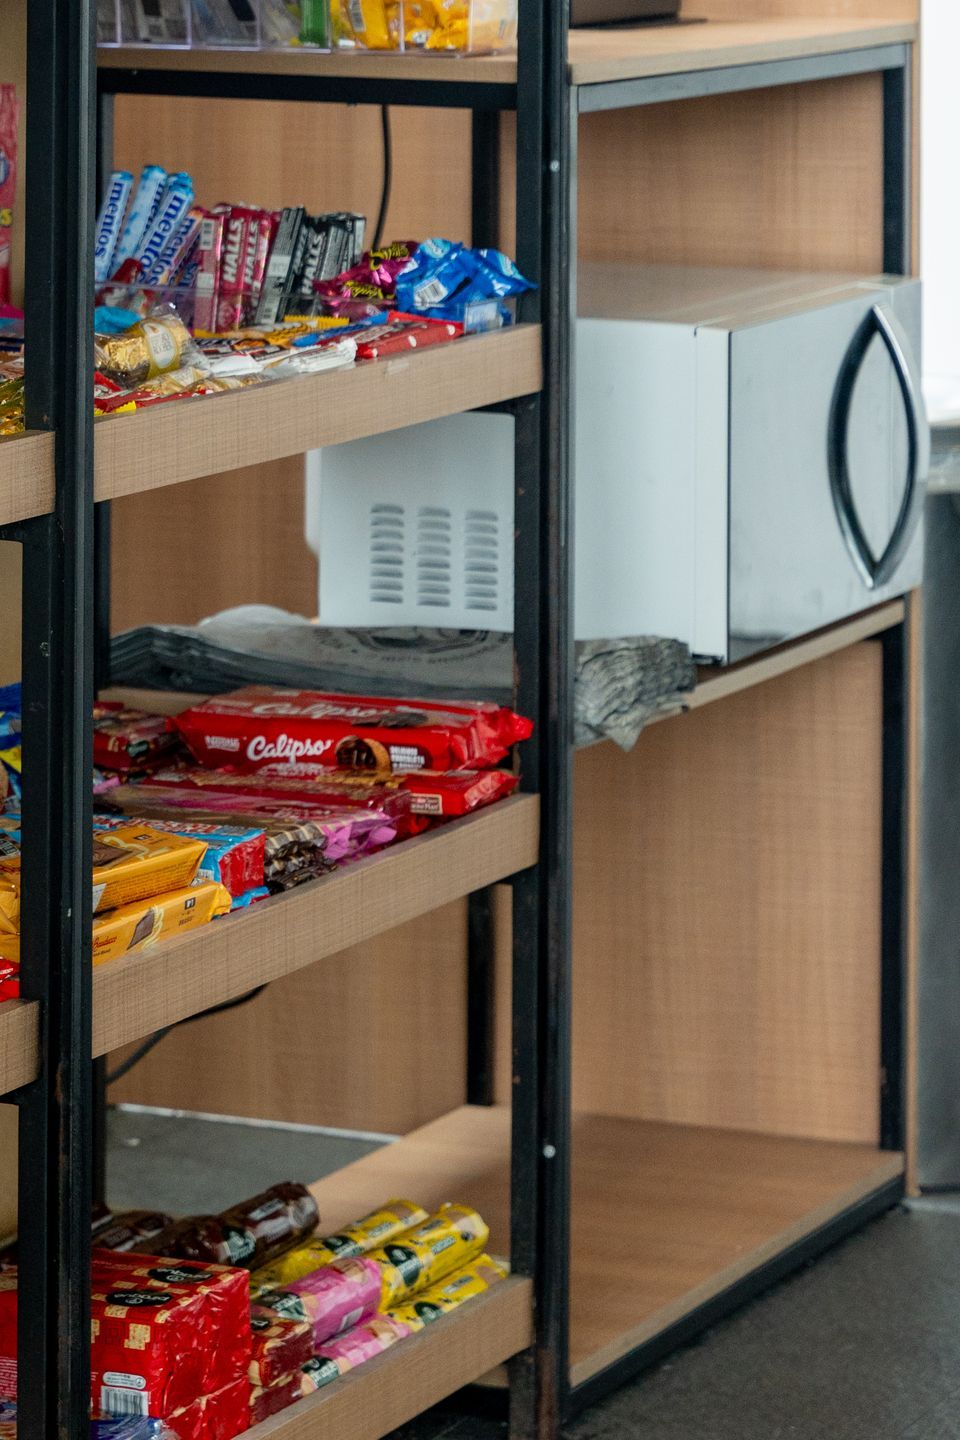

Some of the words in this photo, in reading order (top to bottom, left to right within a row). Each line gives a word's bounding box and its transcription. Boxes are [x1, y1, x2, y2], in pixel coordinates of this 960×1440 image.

[95, 181, 124, 257] mentos
[222, 216, 244, 283] HALLS
[244, 220, 259, 285] HALLS
[246, 734, 331, 765] Calipso
